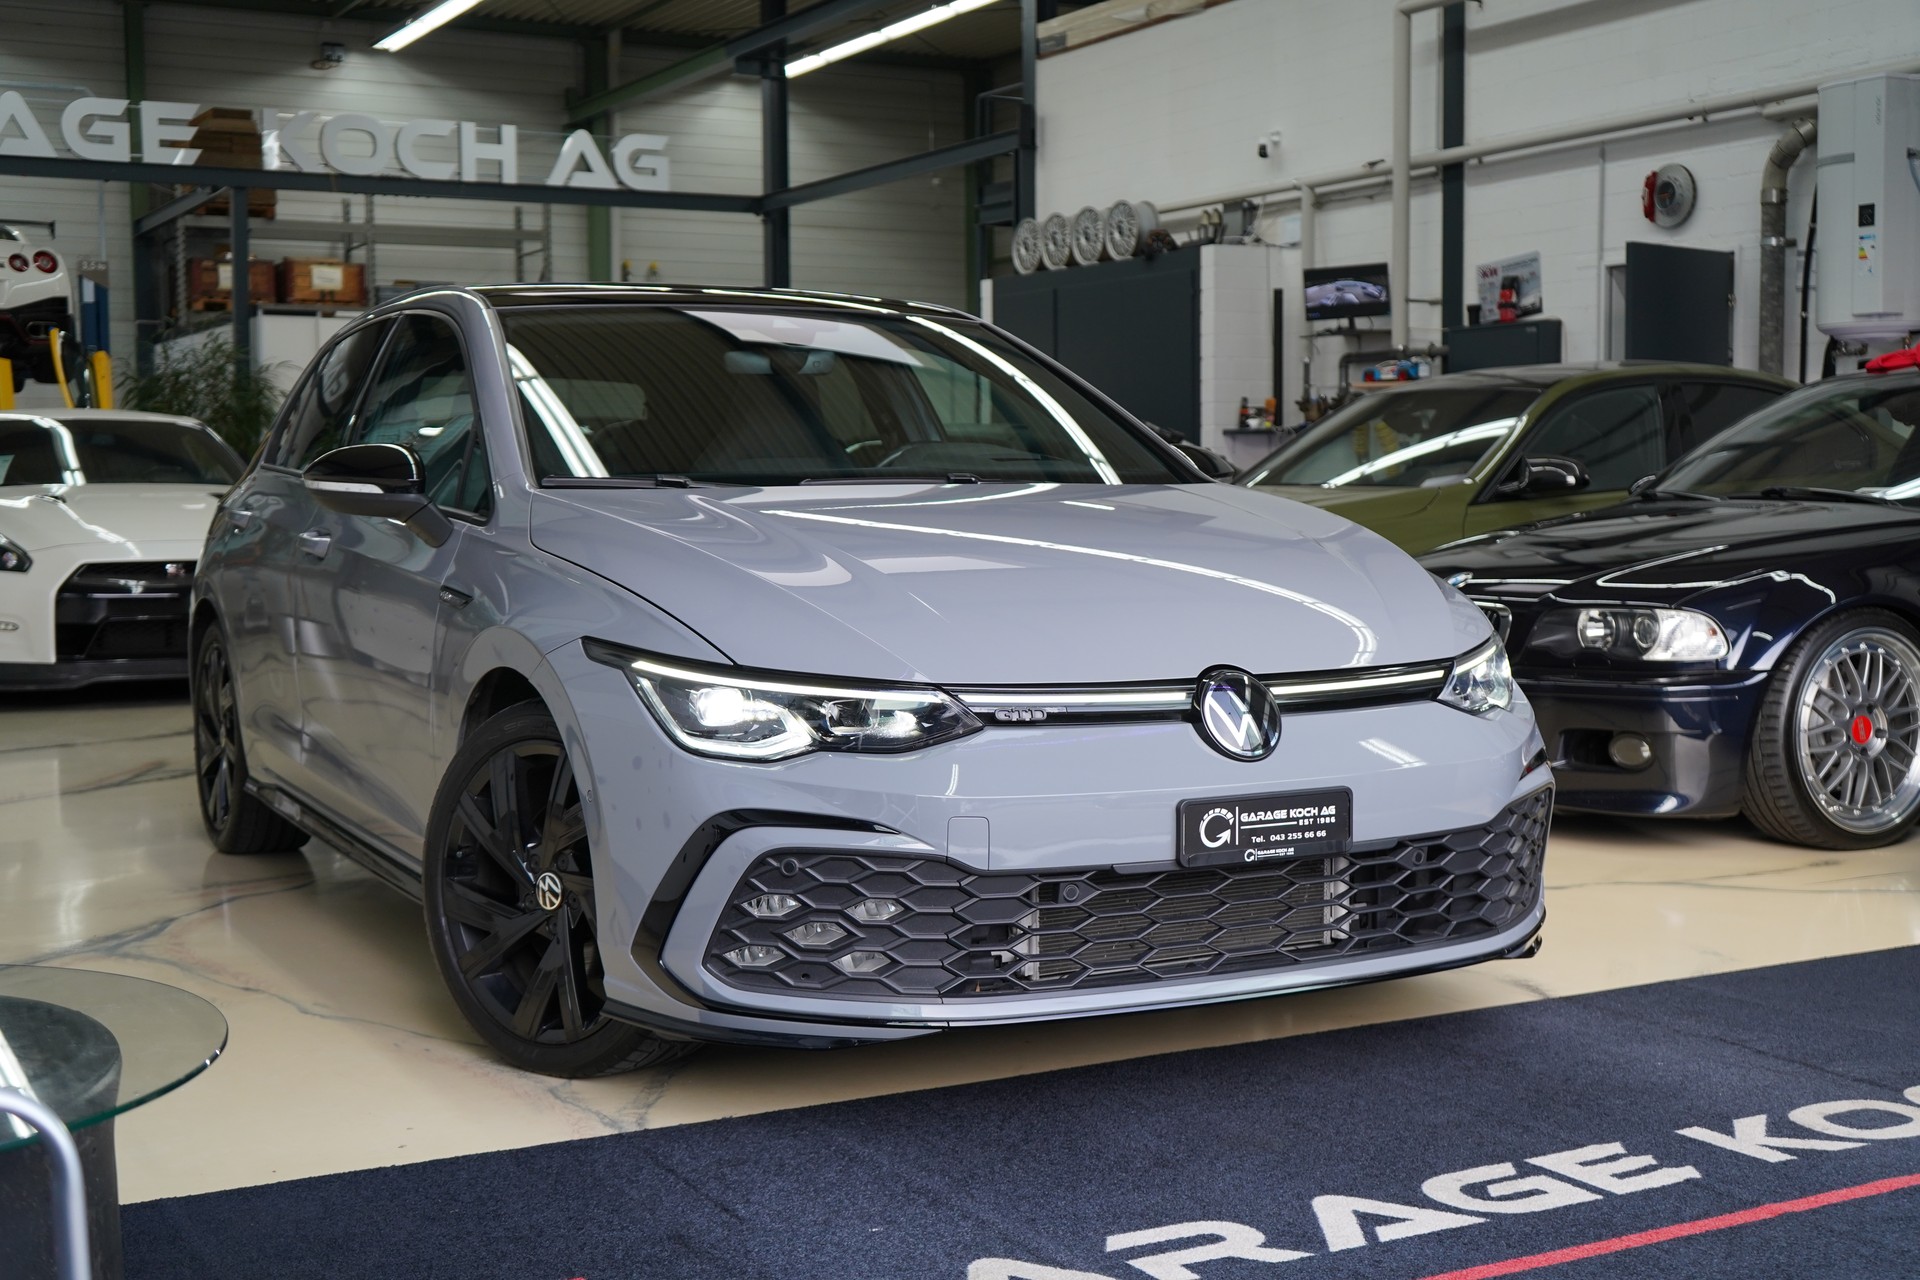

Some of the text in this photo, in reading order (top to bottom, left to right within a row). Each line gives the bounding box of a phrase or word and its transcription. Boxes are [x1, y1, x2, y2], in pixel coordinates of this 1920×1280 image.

[262, 108, 518, 185] KOCH
[545, 128, 670, 192] AG
[1240, 805, 1336, 822] GARAGE KOCH AG
[1298, 818, 1314, 826] EST
[1251, 830, 1327, 844] Tel. 043 255 66 66
[1675, 1085, 1920, 1163] KO
